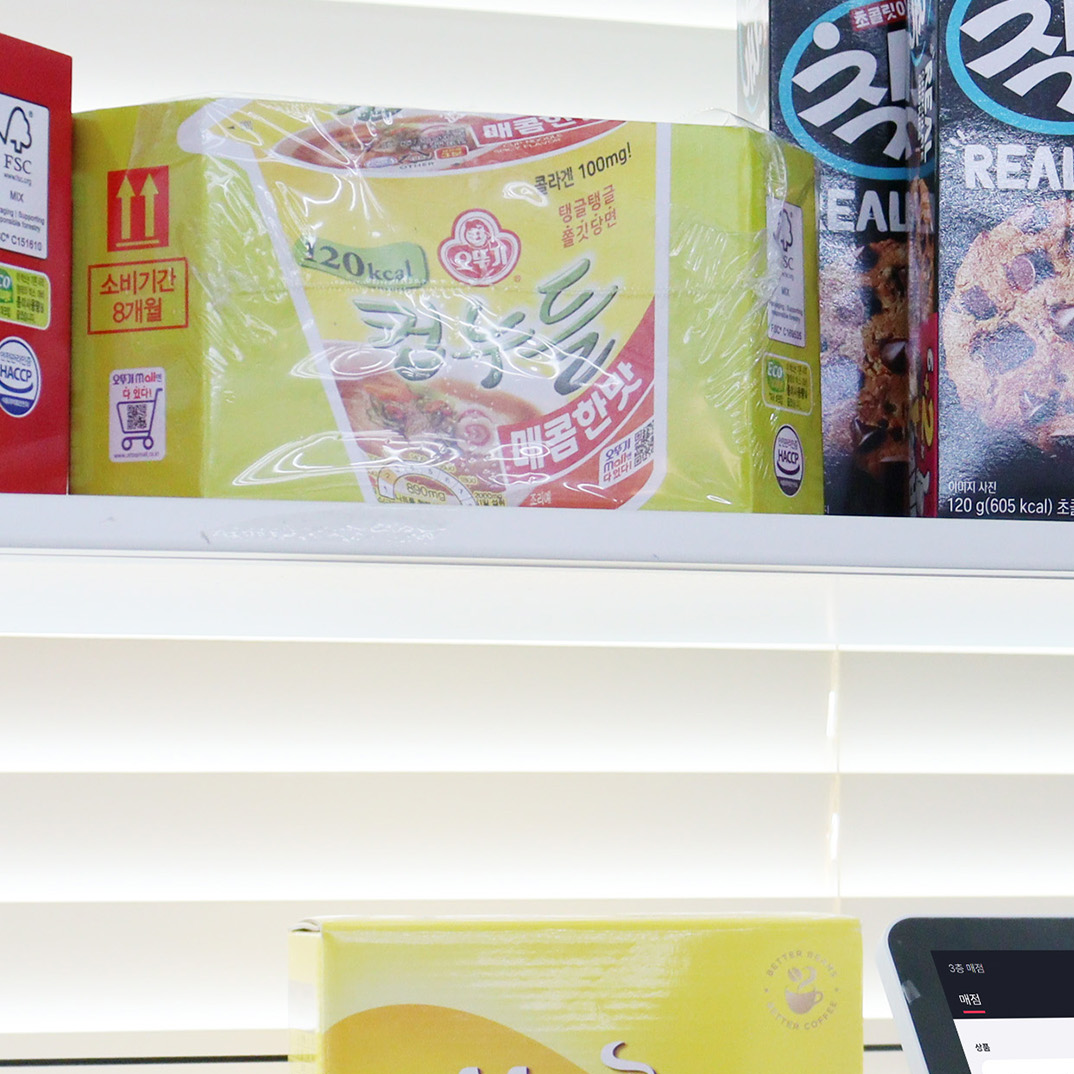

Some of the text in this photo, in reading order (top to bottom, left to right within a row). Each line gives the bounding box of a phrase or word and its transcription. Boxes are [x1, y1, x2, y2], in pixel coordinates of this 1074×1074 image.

[4, 153, 33, 175] FSC
[534, 142, 632, 195] 콜라겐 100mg!
[10, 190, 24, 203] MIX
[558, 184, 617, 219] 탱글탱글
[561, 208, 618, 248] 쫄깃당면
[455, 241, 510, 274] 오뚜기
[99, 267, 176, 295] 소비기간
[112, 297, 162, 323] 8개월
[509, 360, 643, 470] 매콤한맛
[778, 449, 799, 465] HACCP
[406, 482, 447, 502] 890mg
[948, 481, 997, 495] 이미지 사진
[948, 497, 972, 513] 120
[976, 497, 1014, 517] g(605
[1019, 497, 1053, 516] kcal)
[948, 962, 986, 975] 3층 매점
[959, 993, 982, 1007] 매점
[975, 1042, 991, 1053] 상품
